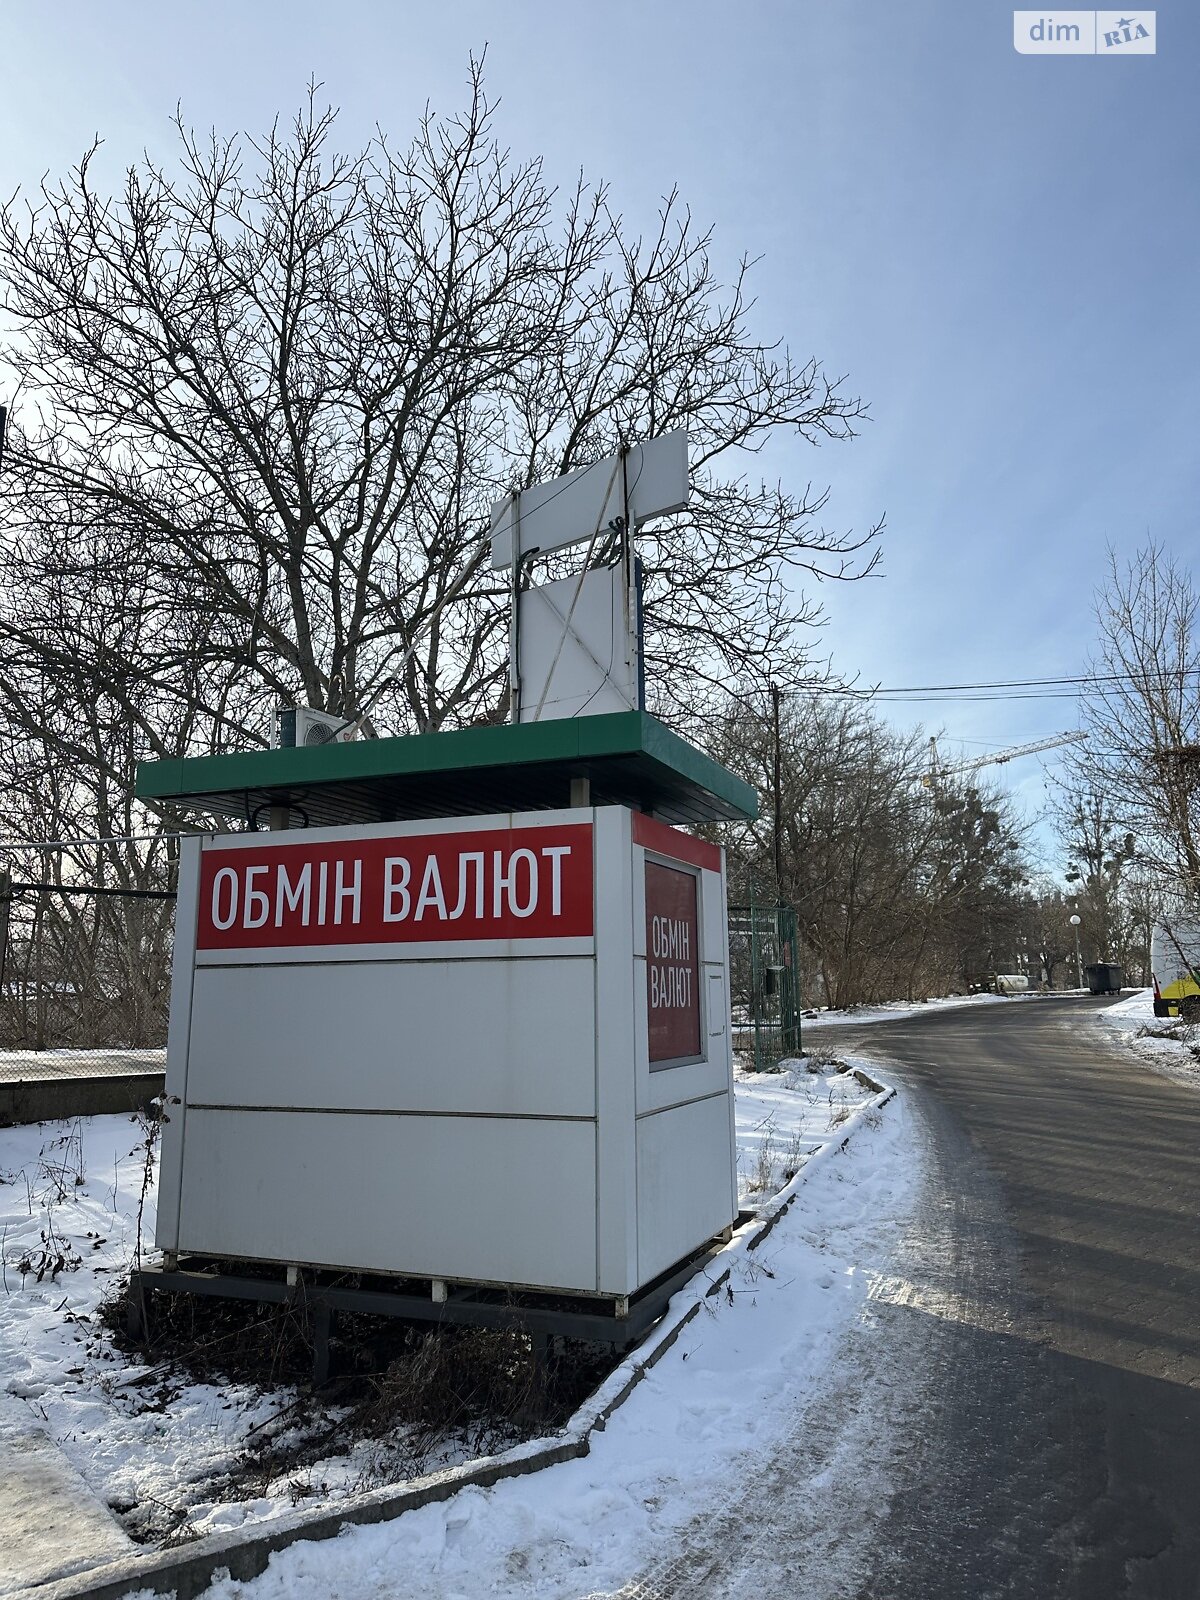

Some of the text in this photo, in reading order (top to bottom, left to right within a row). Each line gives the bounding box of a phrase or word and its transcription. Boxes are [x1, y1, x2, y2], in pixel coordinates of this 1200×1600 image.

[211, 846, 572, 930] ОБМІН ВАЛЮТ
[652, 915, 690, 961] ОБМІН
[651, 965, 692, 1008] ВАЛЮТ
